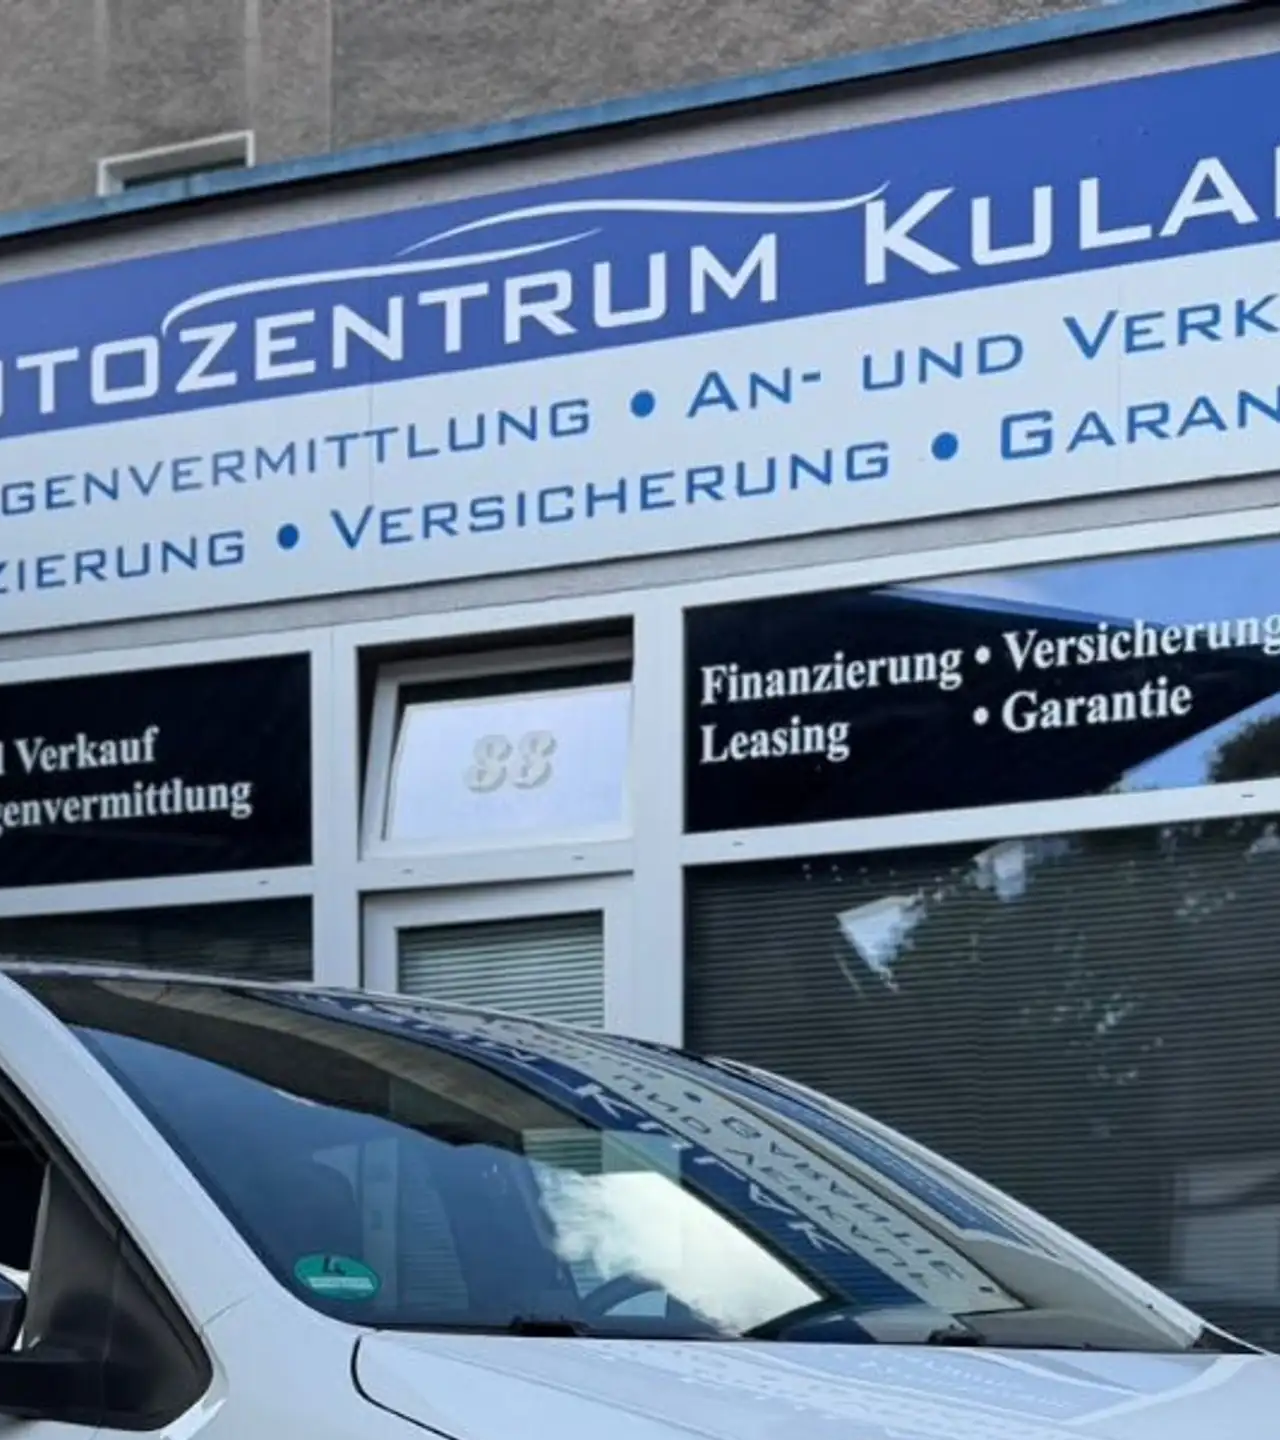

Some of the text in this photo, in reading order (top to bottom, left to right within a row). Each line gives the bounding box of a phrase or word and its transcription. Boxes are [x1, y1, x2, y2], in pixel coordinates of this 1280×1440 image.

[686, 368, 822, 419] AN-
[862, 332, 1024, 391] UND
[330, 440, 890, 549] VERSICHERUNG
[700, 645, 963, 706] Finanzierung
[15, 724, 160, 776] Verkauf
[700, 677, 1193, 764] Leasing Garantie
[463, 729, 558, 794] 88
